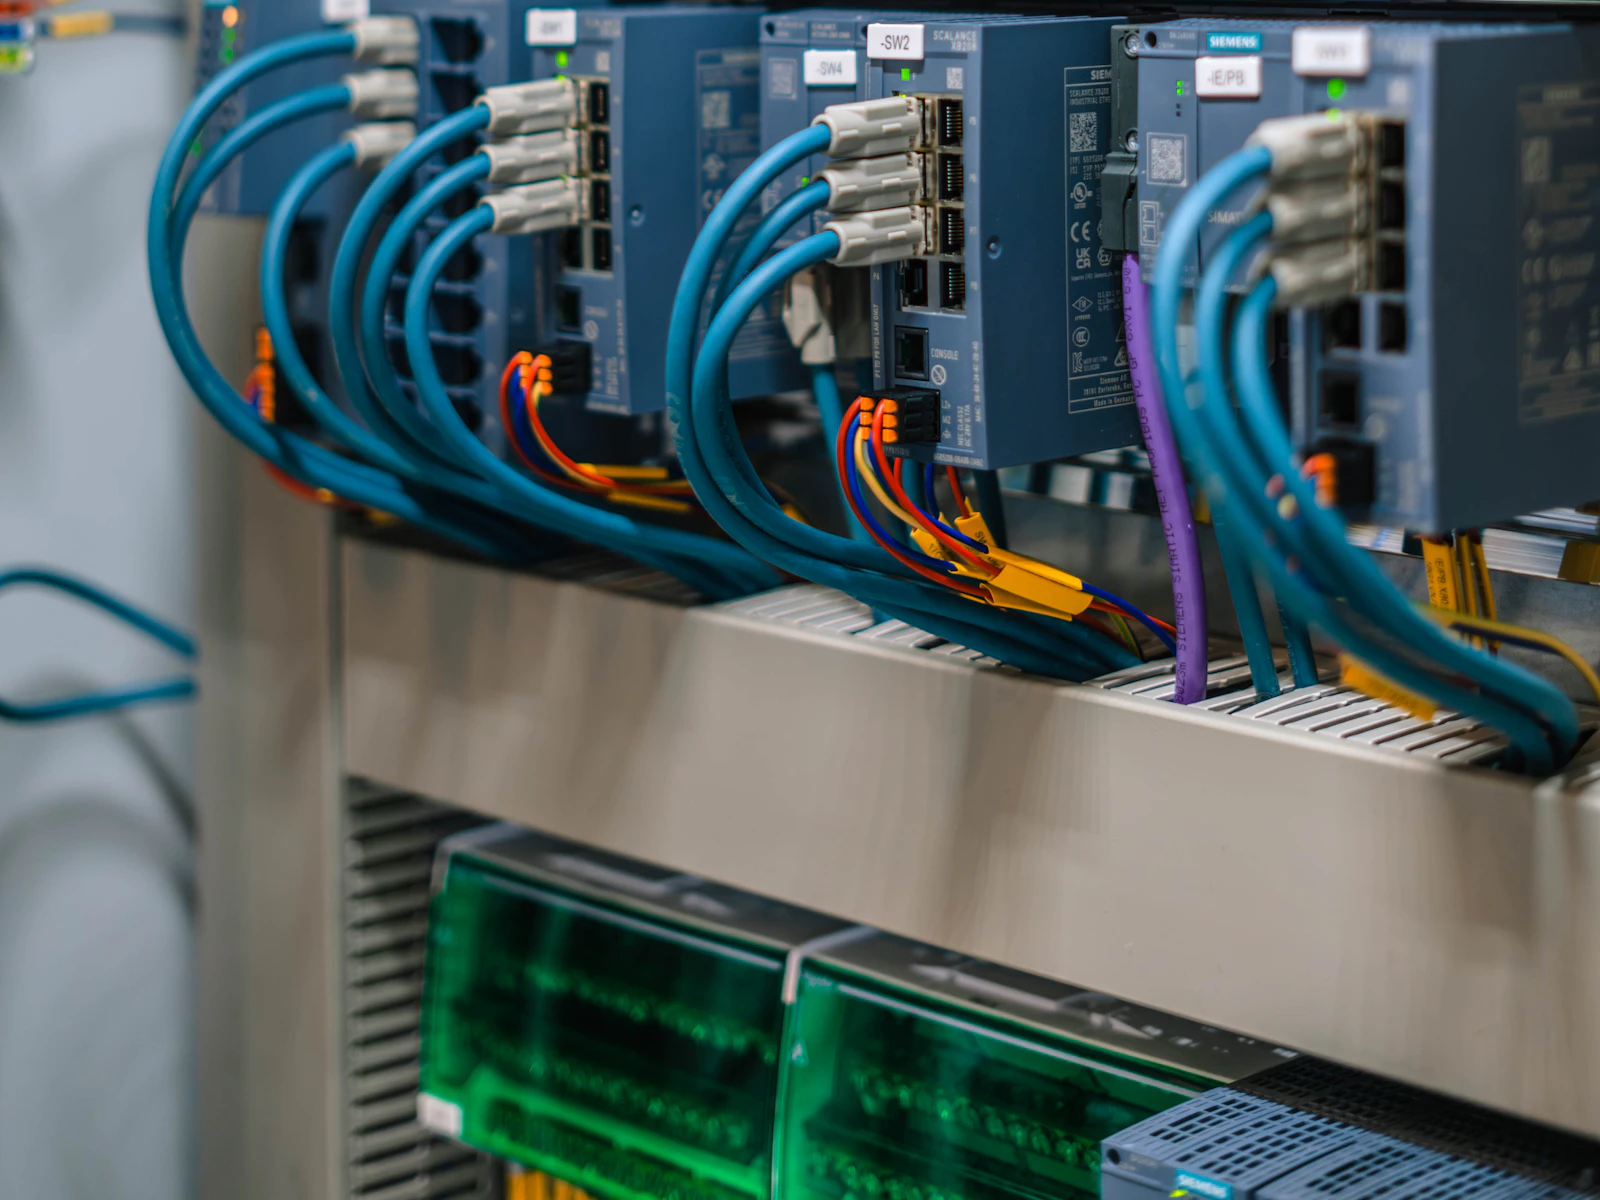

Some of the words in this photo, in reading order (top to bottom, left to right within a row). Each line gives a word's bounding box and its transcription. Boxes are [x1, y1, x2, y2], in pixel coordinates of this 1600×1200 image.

[933, 30, 977, 41] SCALANCE
[1209, 35, 1257, 49] SIEMENS
[880, 35, 910, 51] -SW2
[816, 61, 842, 76] -SW4
[1207, 69, 1245, 86] -IE/PB
[1069, 88, 1094, 98] SCALANCE
[1069, 97, 1098, 106] INDUSTRIAL
[1070, 220, 1091, 243] CE
[1075, 247, 1091, 259] UK
[1076, 258, 1091, 269] CA
[930, 347, 959, 361] CONSOLE
[874, 360, 881, 368] TO
[1100, 376, 1119, 385] Siemens
[1132, 379, 1143, 399] FC
[1164, 522, 1181, 584] SIMATIC
[1176, 592, 1187, 652] SIEMENS
